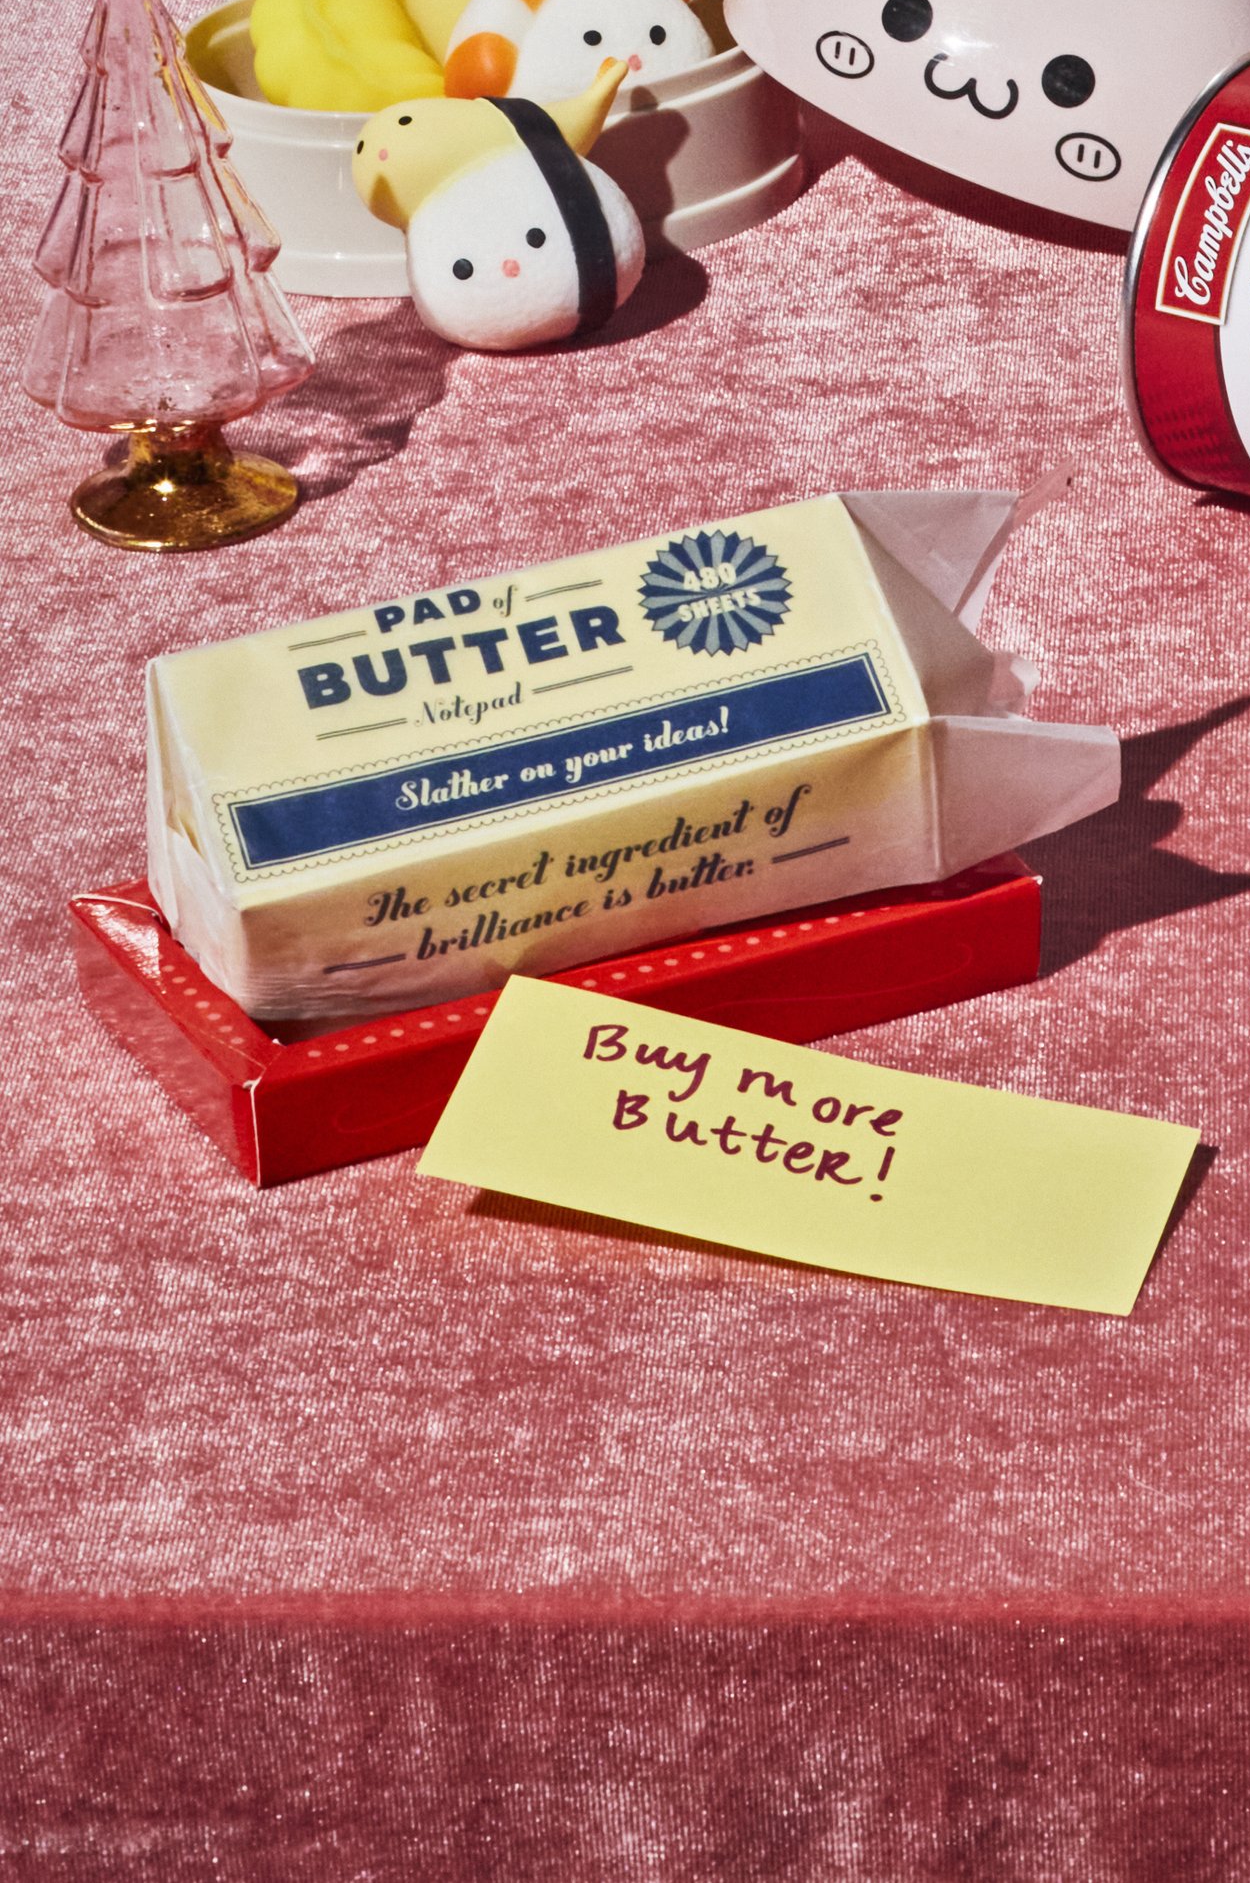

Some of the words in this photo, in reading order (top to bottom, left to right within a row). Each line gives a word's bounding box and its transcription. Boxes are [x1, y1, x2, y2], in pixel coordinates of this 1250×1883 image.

[374, 588, 482, 634] PAD
[492, 582, 520, 618] of
[677, 587, 762, 622] SHEETS
[683, 562, 737, 591] 480
[297, 605, 626, 710] BUTTER
[414, 681, 524, 727] Notepad
[395, 768, 509, 811] Slather
[520, 758, 557, 783] on
[565, 742, 633, 783] your
[643, 706, 730, 754] ideas!
[362, 886, 431, 928] The
[444, 851, 555, 908] secret
[565, 799, 756, 884] ingredient
[763, 783, 813, 837] of
[416, 901, 592, 961] brilliance
[603, 886, 633, 911] is
[646, 851, 756, 901] butter.
[583, 1024, 712, 1103] Buy
